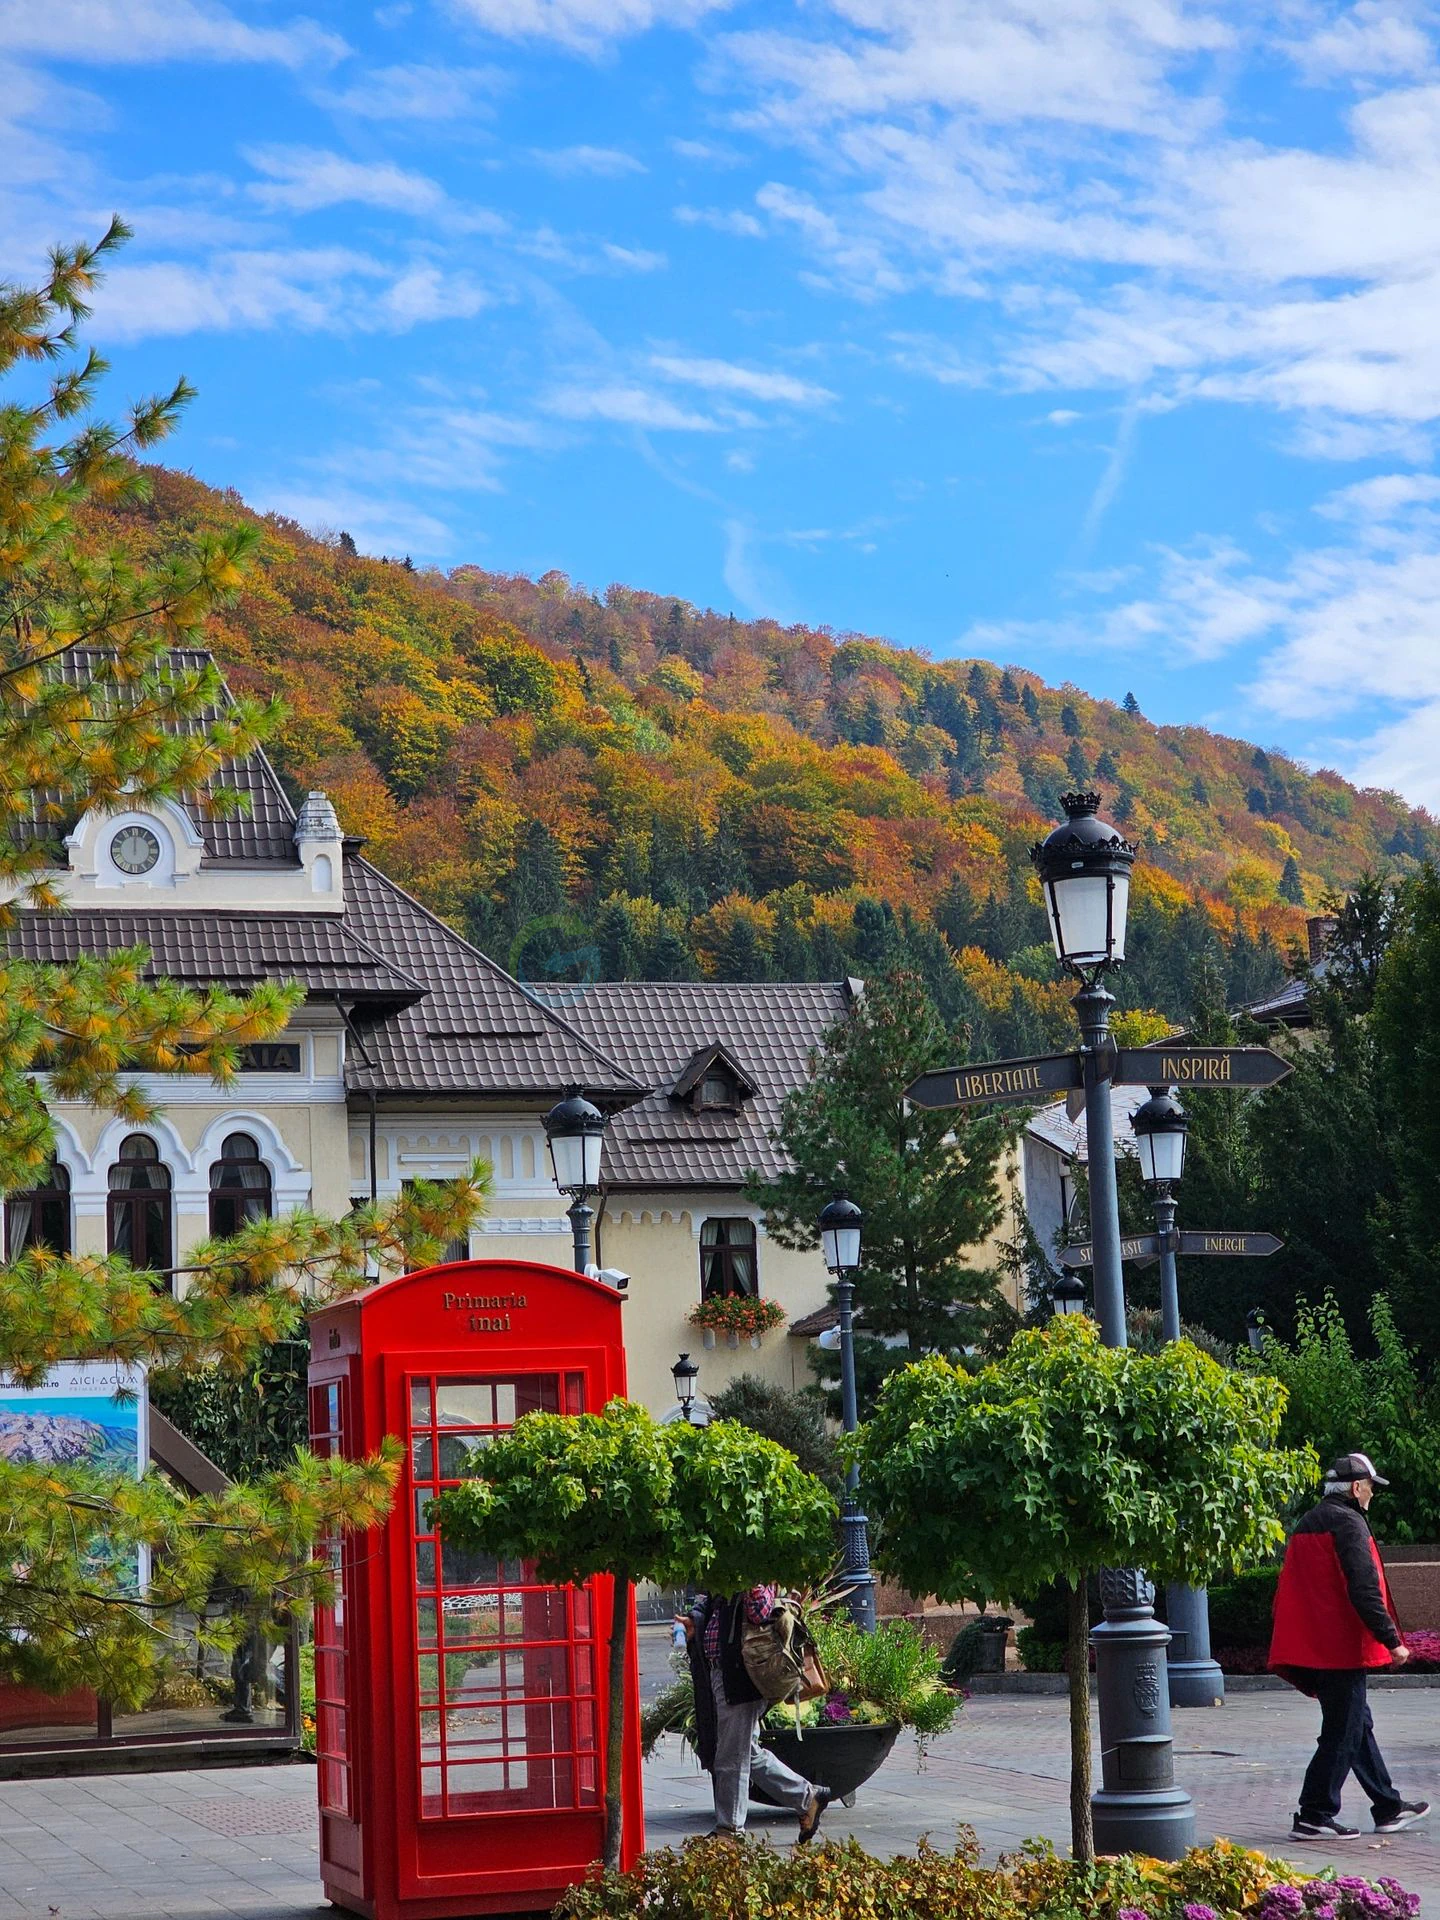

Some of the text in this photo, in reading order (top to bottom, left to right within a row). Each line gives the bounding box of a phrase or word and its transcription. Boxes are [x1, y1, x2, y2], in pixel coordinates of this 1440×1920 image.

[1162, 1055, 1231, 1081] INSPIRĂ
[955, 1066, 1044, 1100] LIBERTATE
[1205, 1238, 1248, 1251] ENERGIE
[444, 1291, 528, 1310] Primaria
